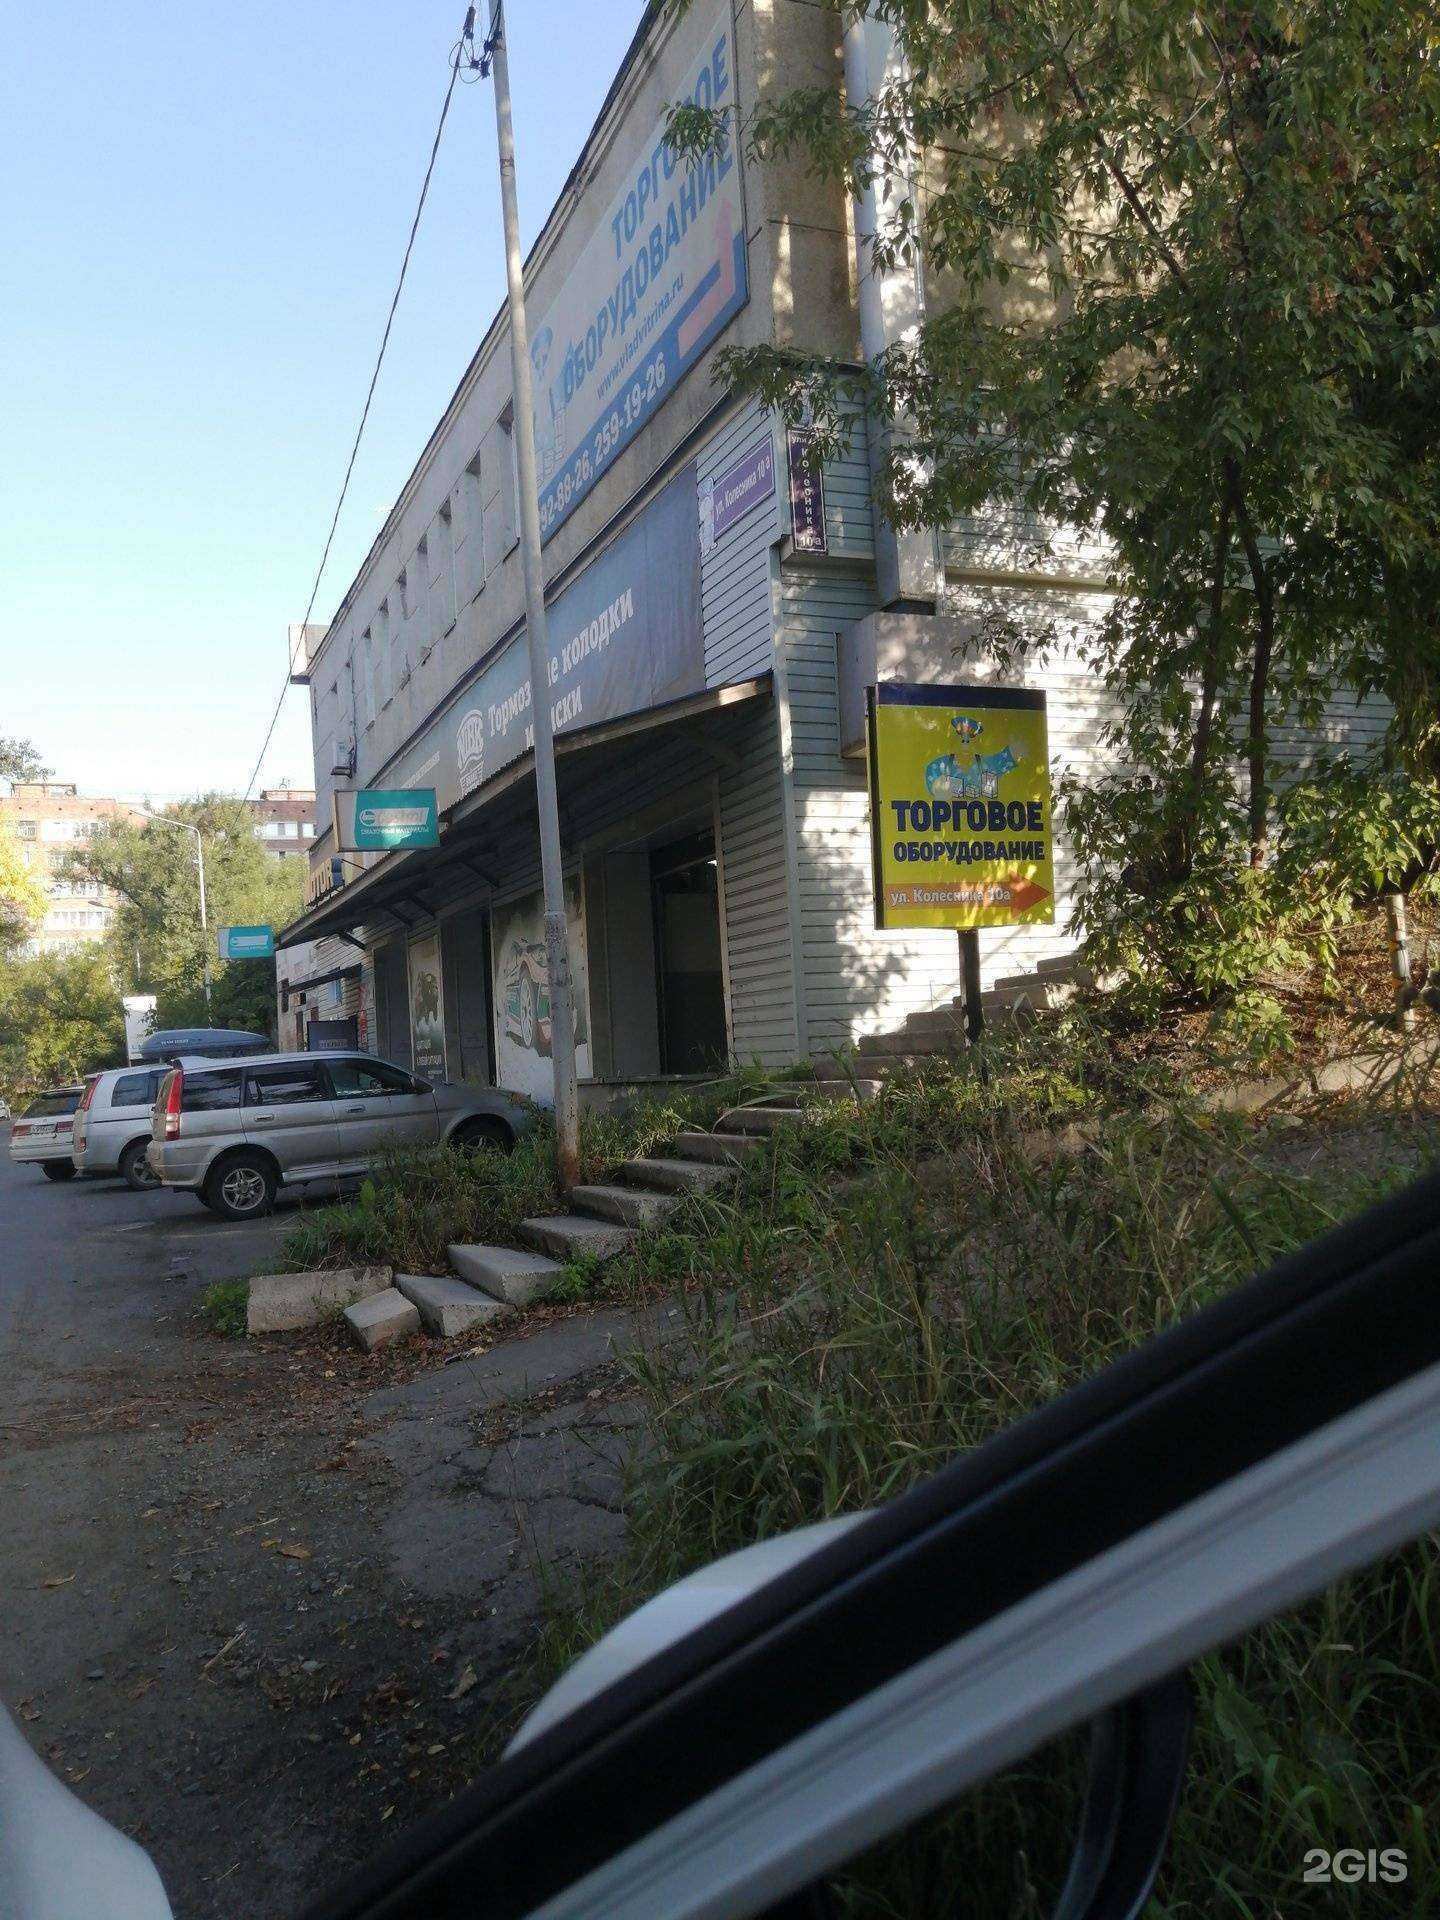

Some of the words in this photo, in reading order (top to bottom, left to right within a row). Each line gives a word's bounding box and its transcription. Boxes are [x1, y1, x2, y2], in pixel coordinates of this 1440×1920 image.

[611, 31, 729, 260] ТОРГООЕ
[488, 655, 559, 736] Тормозе
[562, 588, 634, 676] колодки
[551, 685, 583, 733] ски
[891, 800, 1044, 832] ТОРГОВОЕ
[893, 841, 1045, 865] ОБОРУДОВАНИЕ
[890, 891, 910, 906] ул.
[913, 888, 984, 902] Колесника
